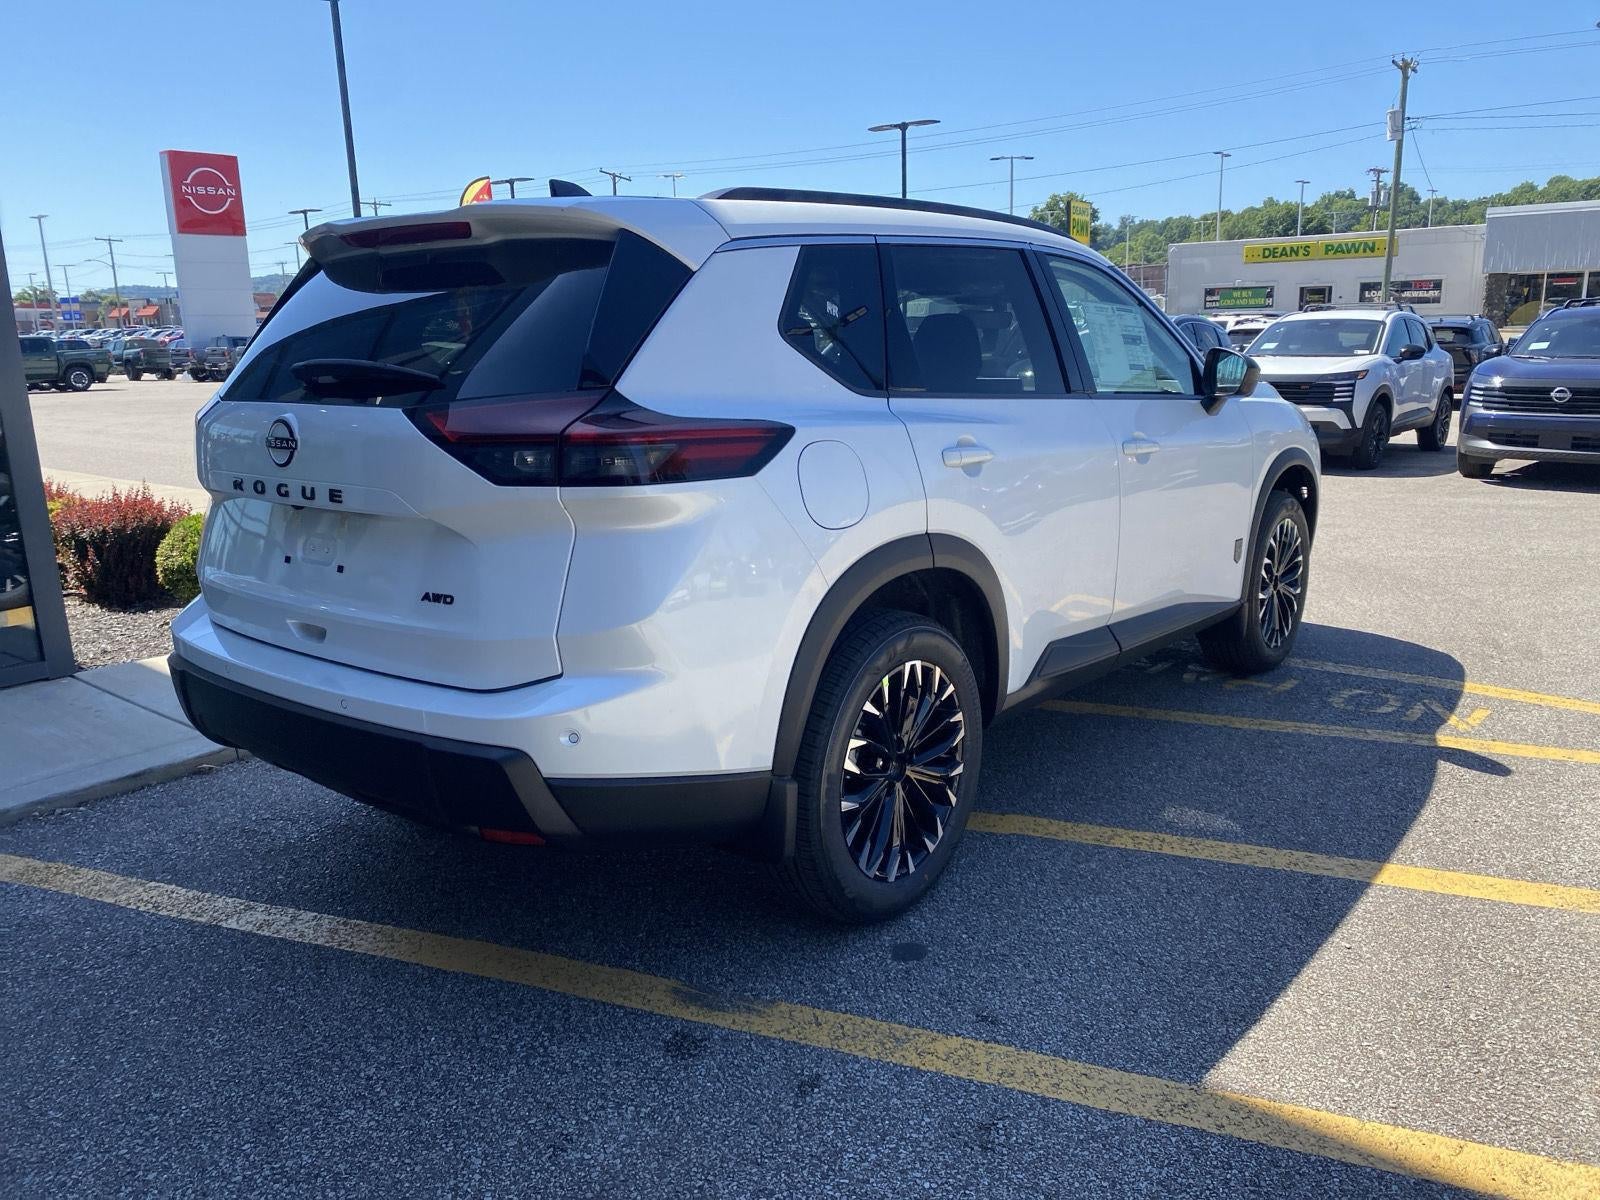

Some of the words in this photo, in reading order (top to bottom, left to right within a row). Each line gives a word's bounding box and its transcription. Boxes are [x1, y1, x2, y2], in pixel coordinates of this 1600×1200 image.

[182, 185, 236, 196] NISSAN
[1262, 244, 1311, 259] DEAN'S
[1324, 241, 1377, 256] PAWN
[1220, 298, 1235, 306] GOLD
[232, 477, 343, 504] ROGUE
[420, 591, 455, 605] AWD
